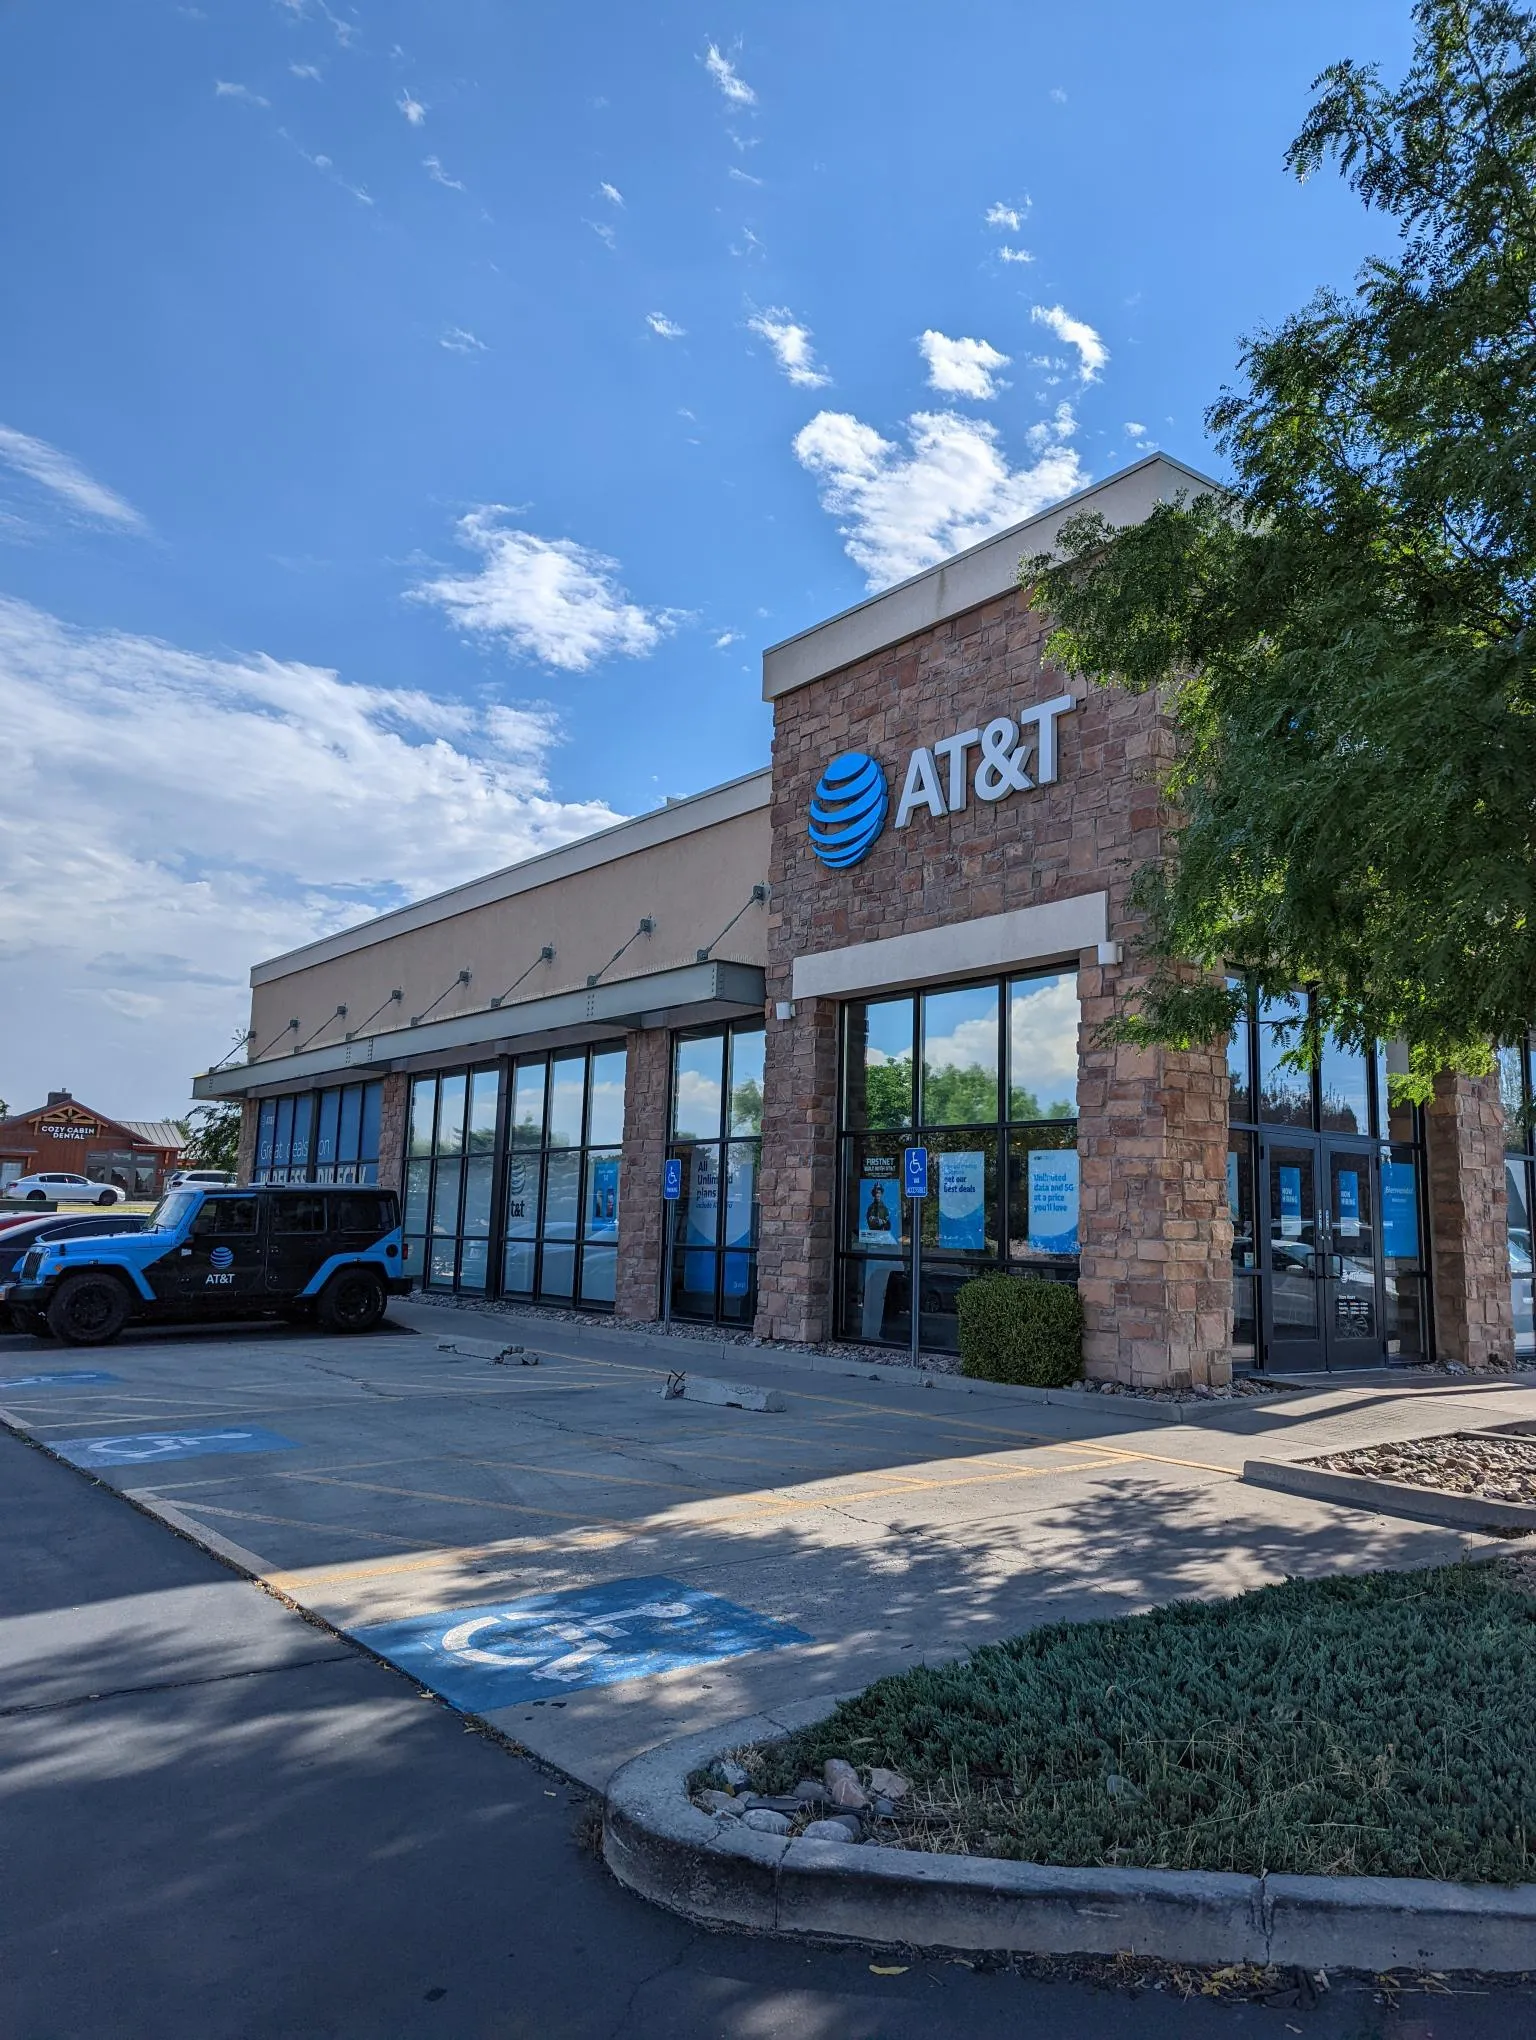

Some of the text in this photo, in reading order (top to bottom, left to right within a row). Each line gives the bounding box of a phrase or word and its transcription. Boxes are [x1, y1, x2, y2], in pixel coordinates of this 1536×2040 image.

[894, 695, 1077, 829] AT&T
[53, 1132, 85, 1140] DENTAL
[318, 1139, 330, 1156] on
[698, 1160, 708, 1172] All
[866, 1157, 895, 1166] FIRSTNET
[943, 1184, 976, 1193] best deals
[1033, 1183, 1050, 1191] data
[1050, 1183, 1063, 1191] and
[696, 1187, 717, 1201] plans
[1047, 1193, 1065, 1203] price
[1053, 1203, 1067, 1211] love
[205, 1273, 236, 1285] AT&T
